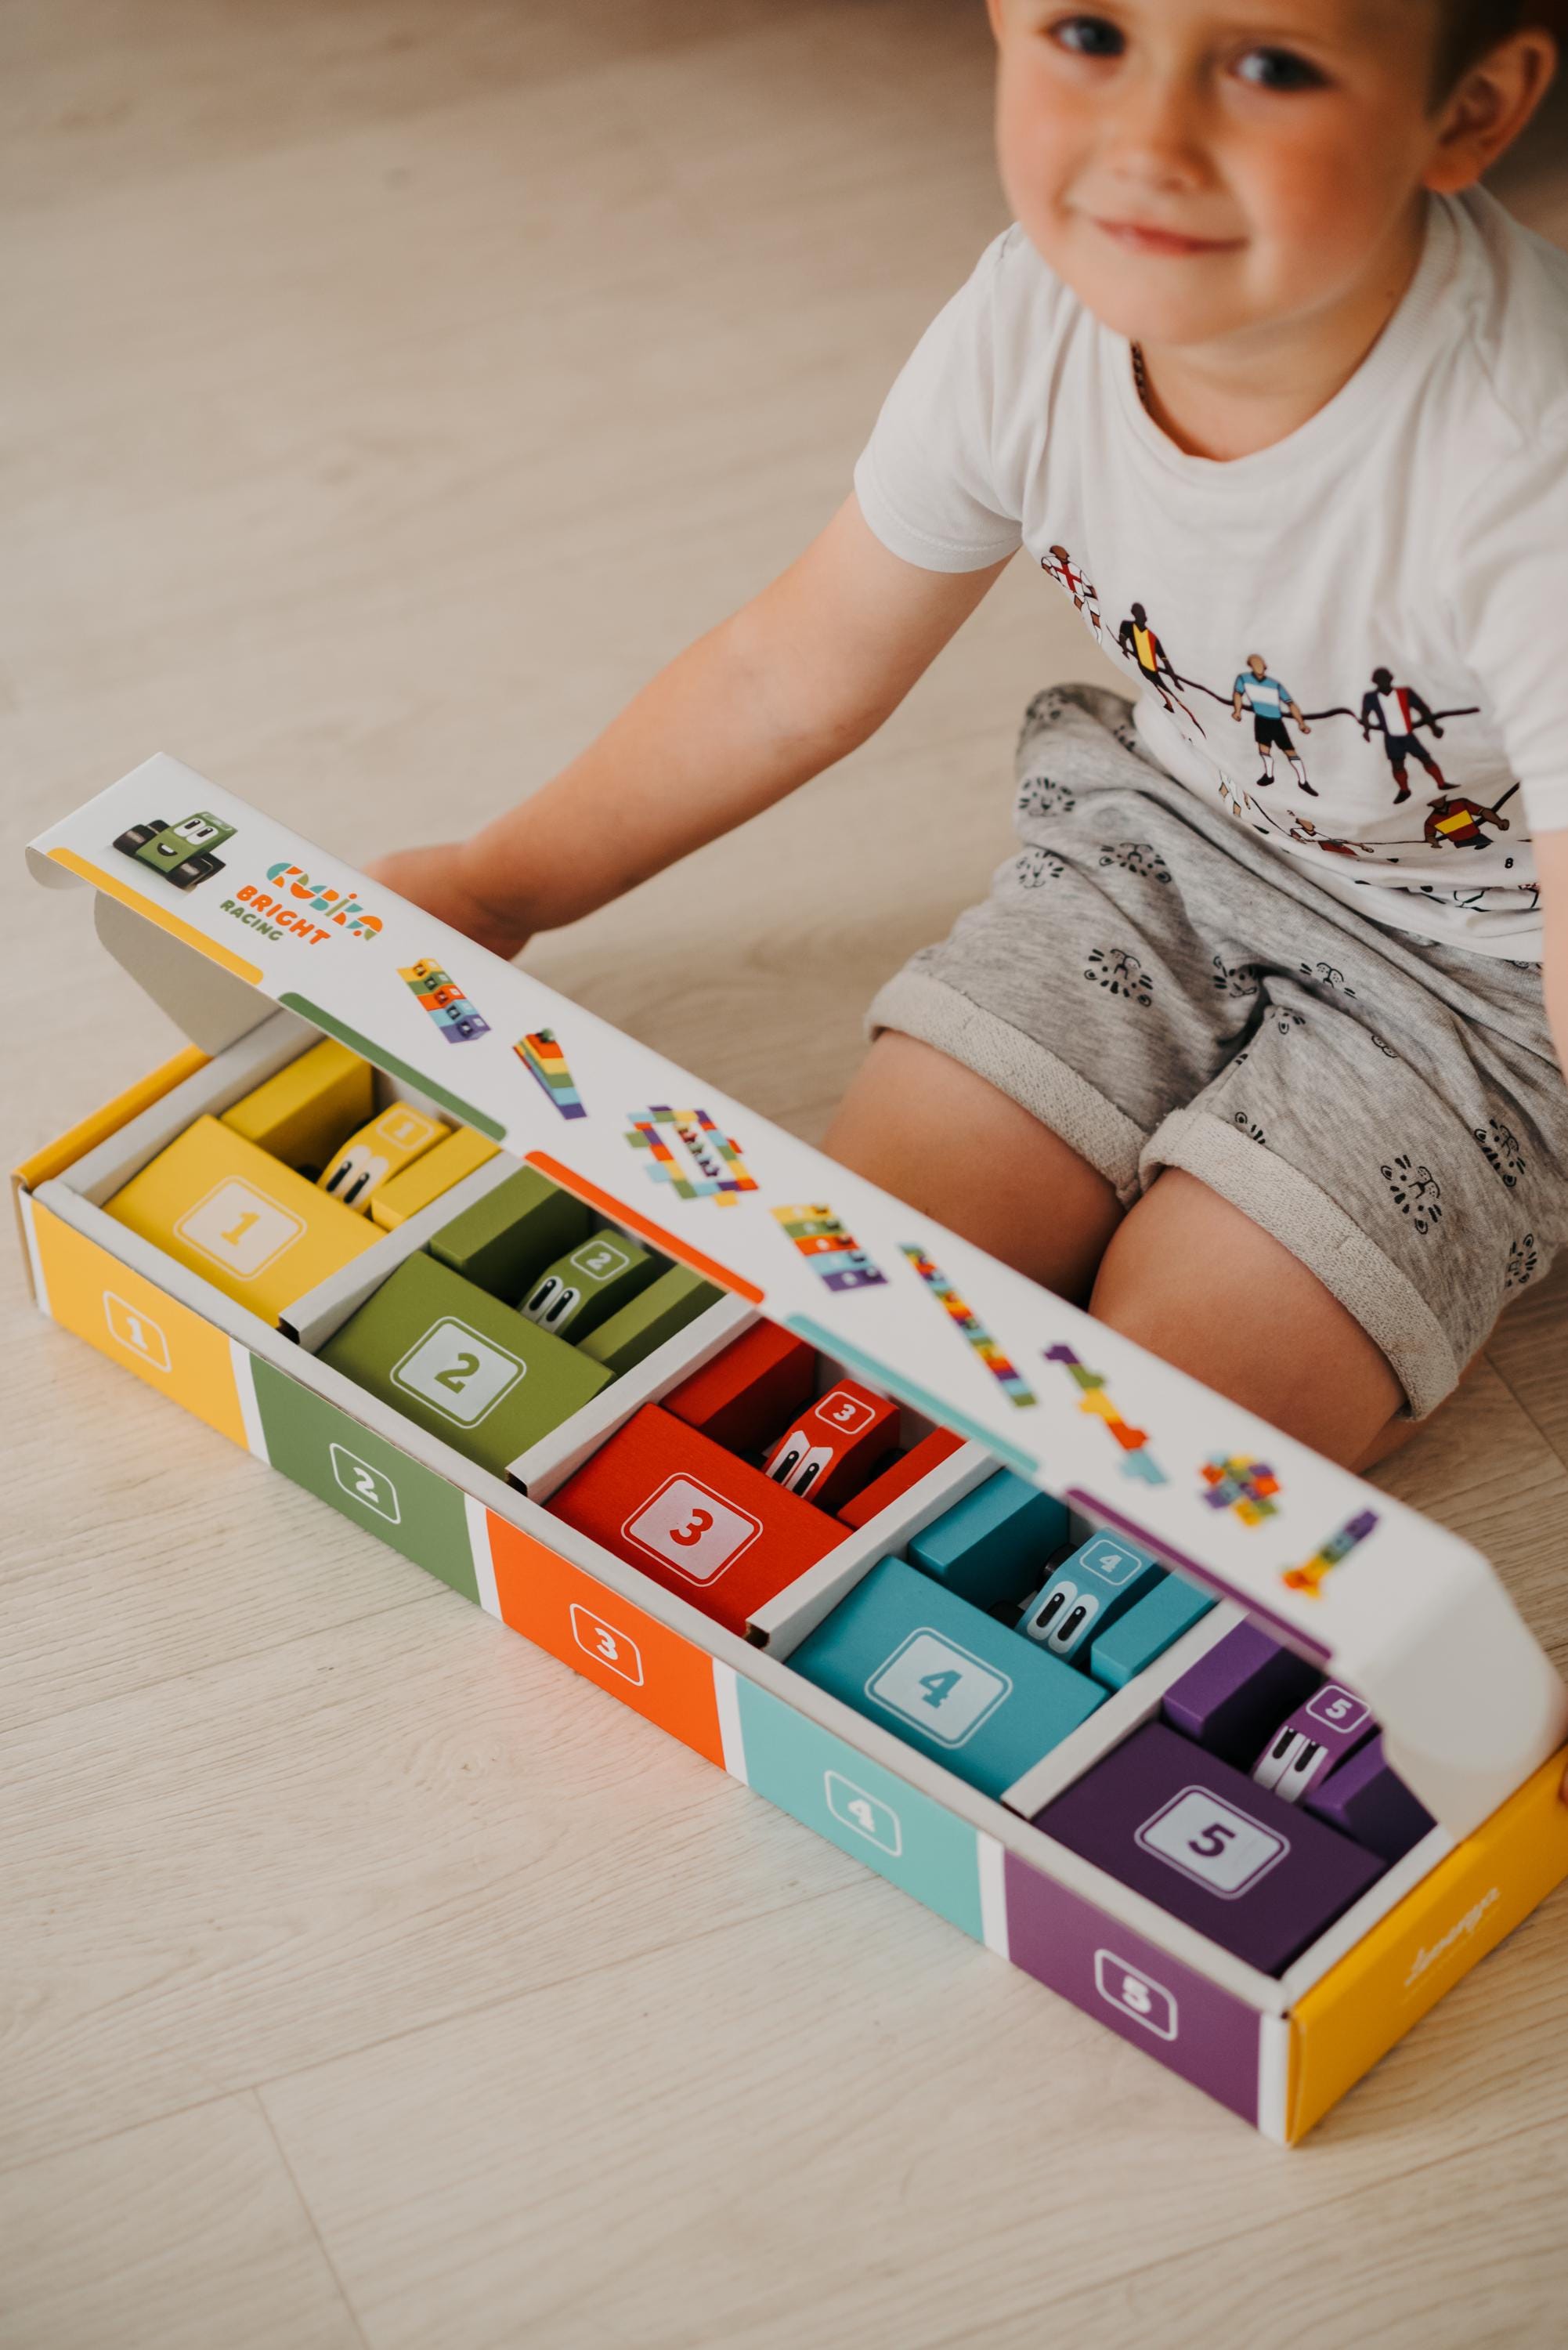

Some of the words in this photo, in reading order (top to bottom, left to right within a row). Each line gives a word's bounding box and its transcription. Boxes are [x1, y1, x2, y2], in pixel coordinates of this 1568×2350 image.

[220, 899, 284, 941] RACING
[237, 885, 331, 945] BRIGHT
[220, 1211, 261, 1246] 1
[586, 1252, 612, 1271] 2
[125, 1317, 148, 1350] 1
[434, 1353, 479, 1394] 2
[833, 1404, 856, 1421] 3
[352, 1466, 378, 1503] 2
[670, 1509, 714, 1546] 3
[1099, 1554, 1122, 1573] 4
[594, 1627, 619, 1660] 3
[919, 1669, 963, 1708] 4
[1325, 1699, 1351, 1719] 5
[847, 1799, 875, 1832] 4
[1188, 1823, 1237, 1858] 5
[1122, 1974, 1151, 2015] 5
